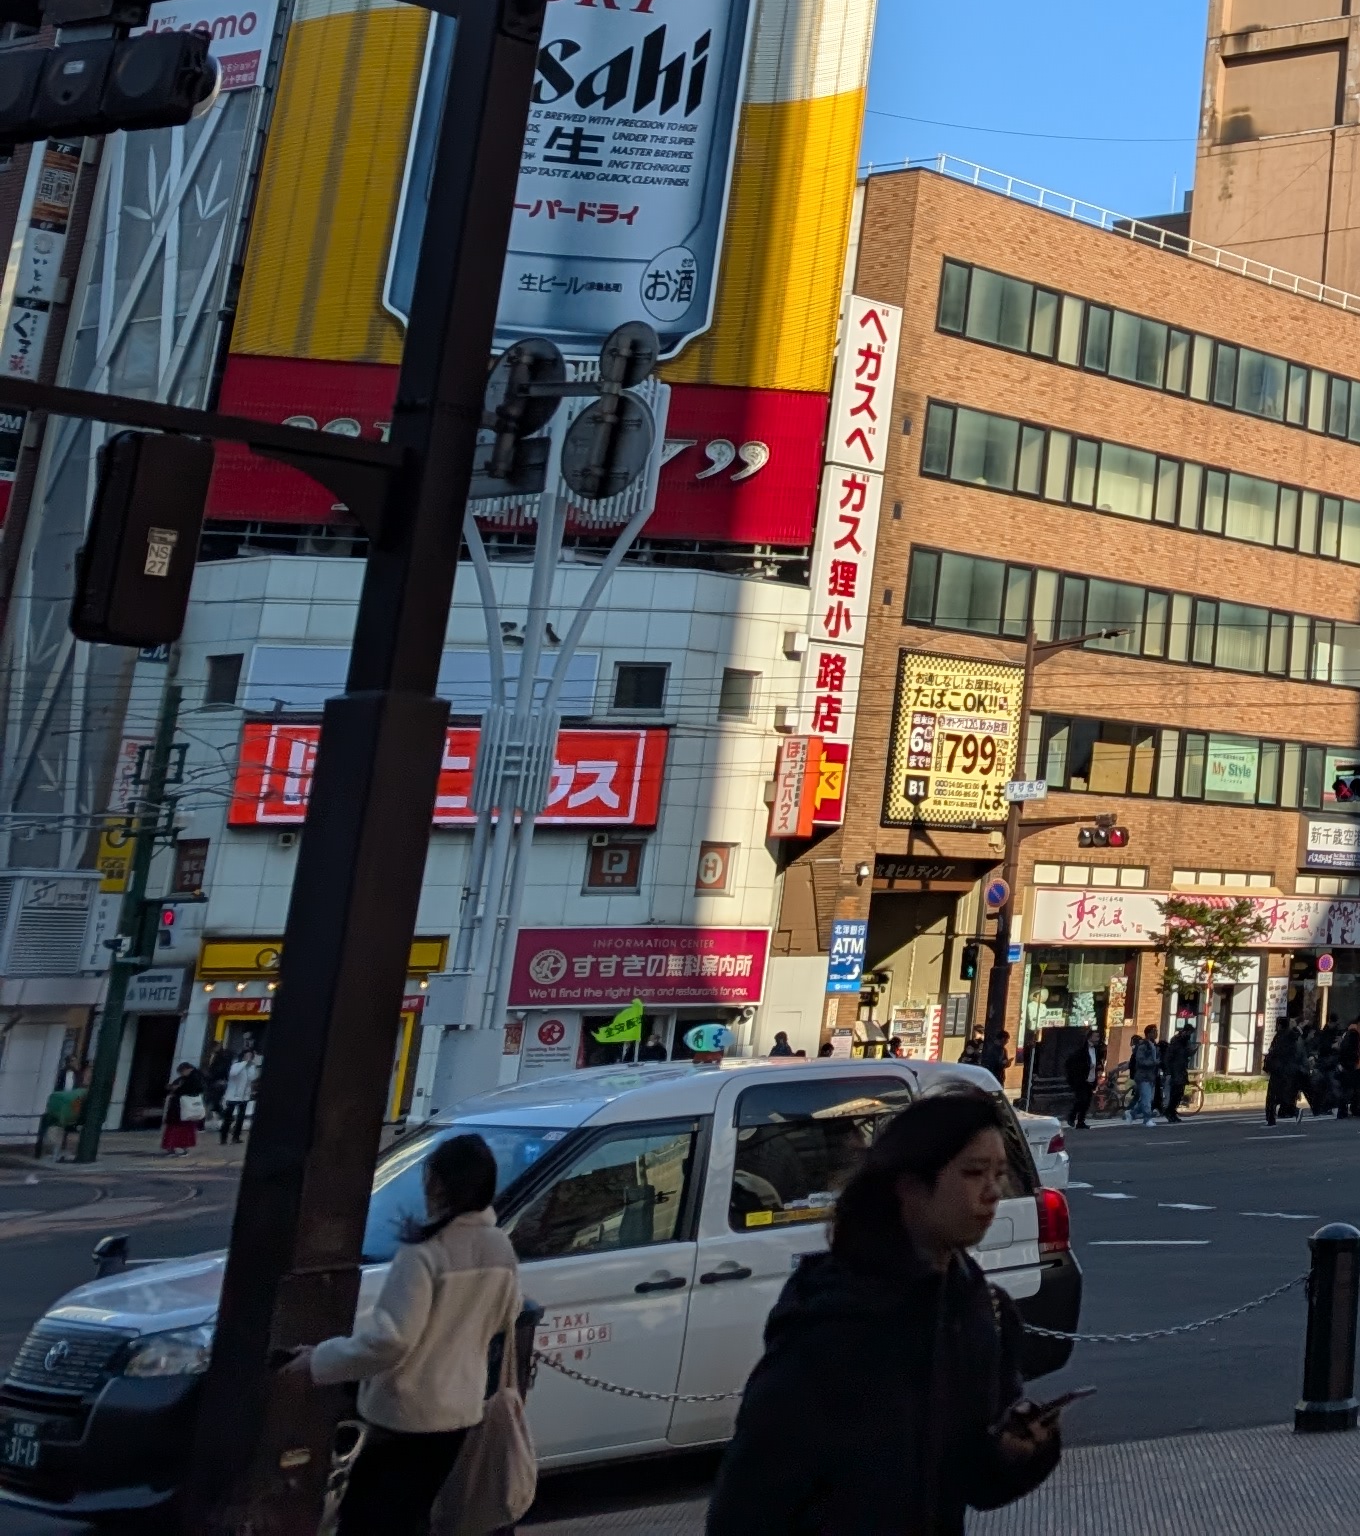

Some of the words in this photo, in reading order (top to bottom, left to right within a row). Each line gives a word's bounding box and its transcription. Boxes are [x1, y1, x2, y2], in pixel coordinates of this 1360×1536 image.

[160, 16, 178, 26] NTT
[533, 24, 712, 117] sahi
[543, 110, 587, 124] BREWED
[588, 115, 615, 126] WITH
[616, 118, 665, 131] PRECISION
[667, 122, 677, 131] TO
[678, 123, 698, 133] HIGH
[543, 126, 605, 167] 生
[612, 132, 648, 143] UNDER
[650, 134, 668, 144] THE
[609, 146, 652, 157] MASTER
[607, 160, 629, 169] ING
[631, 161, 692, 174] TECHNIQUES
[538, 168, 570, 178] TASTE
[571, 171, 596, 181] AND
[632, 175, 662, 186] CLEAN
[514, 199, 640, 226] ーパードライ
[518, 273, 585, 294] 生ビール
[644, 268, 696, 303] お酒
[149, 544, 170, 559] NS
[146, 561, 167, 574] 27
[946, 733, 997, 775] 799
[1212, 761, 1228, 778] My
[1228, 762, 1252, 779] Style
[777, 741, 802, 831] ほっとハウス
[908, 780, 925, 796] B1
[1008, 781, 1045, 793] すすきの
[834, 924, 867, 936] 北洋銀行
[593, 938, 677, 949] INFORMATION
[680, 938, 715, 949] CENTER
[832, 937, 865, 954] ATM
[572, 953, 754, 978] すすきの無料案内所
[830, 954, 862, 966] コーナー
[139, 986, 178, 1002] WHITE
[559, 987, 581, 998] find
[584, 987, 602, 998] the
[605, 987, 631, 1000] right
[633, 987, 655, 998] bars
[657, 987, 674, 998] and
[676, 988, 719, 997] restaurants
[720, 987, 730, 997] for
[927, 1007, 942, 1063] KIRIN
[553, 1312, 590, 1329] TAXI
